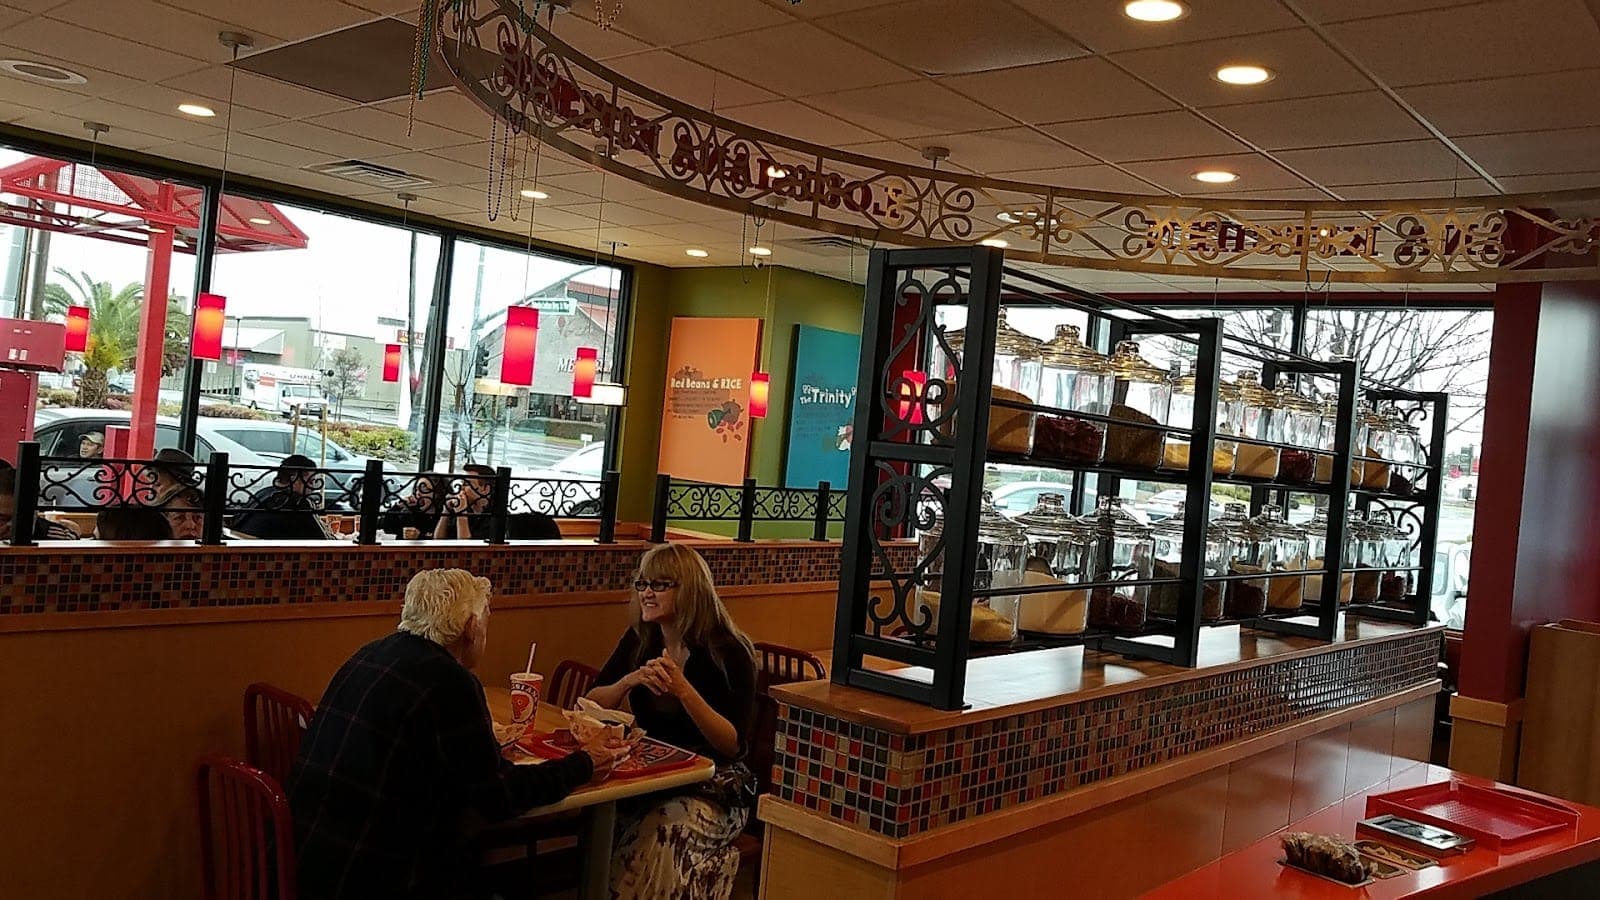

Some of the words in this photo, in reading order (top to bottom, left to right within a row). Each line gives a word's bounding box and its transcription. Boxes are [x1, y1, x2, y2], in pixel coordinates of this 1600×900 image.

[671, 378, 684, 389] Red
[686, 378, 711, 389] Beans
[720, 378, 742, 389] RICE
